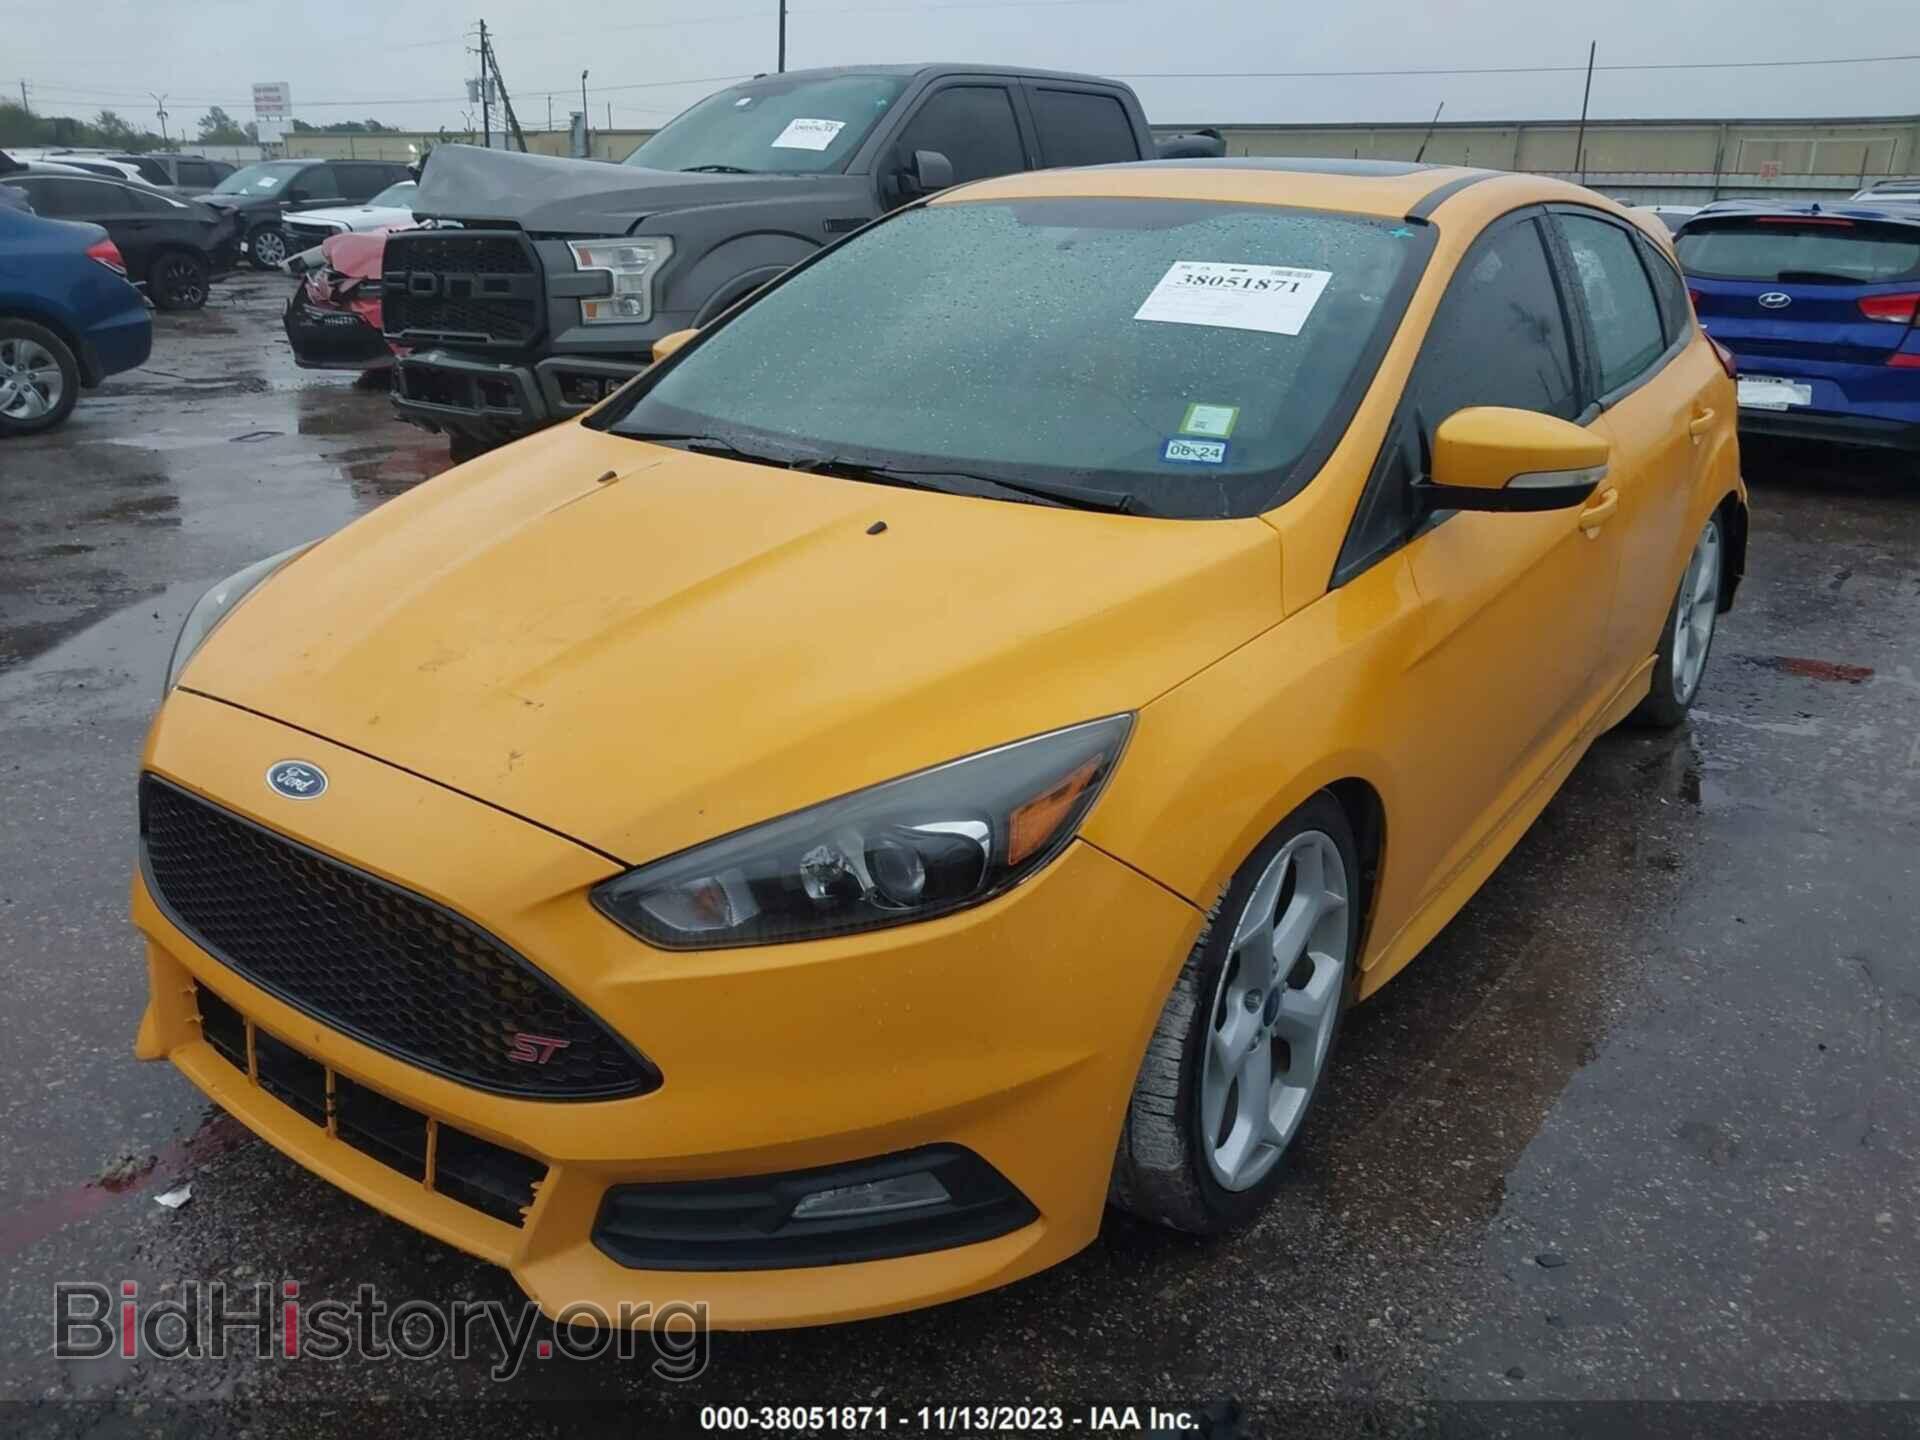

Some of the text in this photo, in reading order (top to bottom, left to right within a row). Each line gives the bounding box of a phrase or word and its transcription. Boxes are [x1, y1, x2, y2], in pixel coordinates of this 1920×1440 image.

[1177, 273, 1301, 293] 38051871
[1199, 446, 1220, 459] 24
[276, 765, 316, 792] Ford
[507, 1032, 572, 1064] ST
